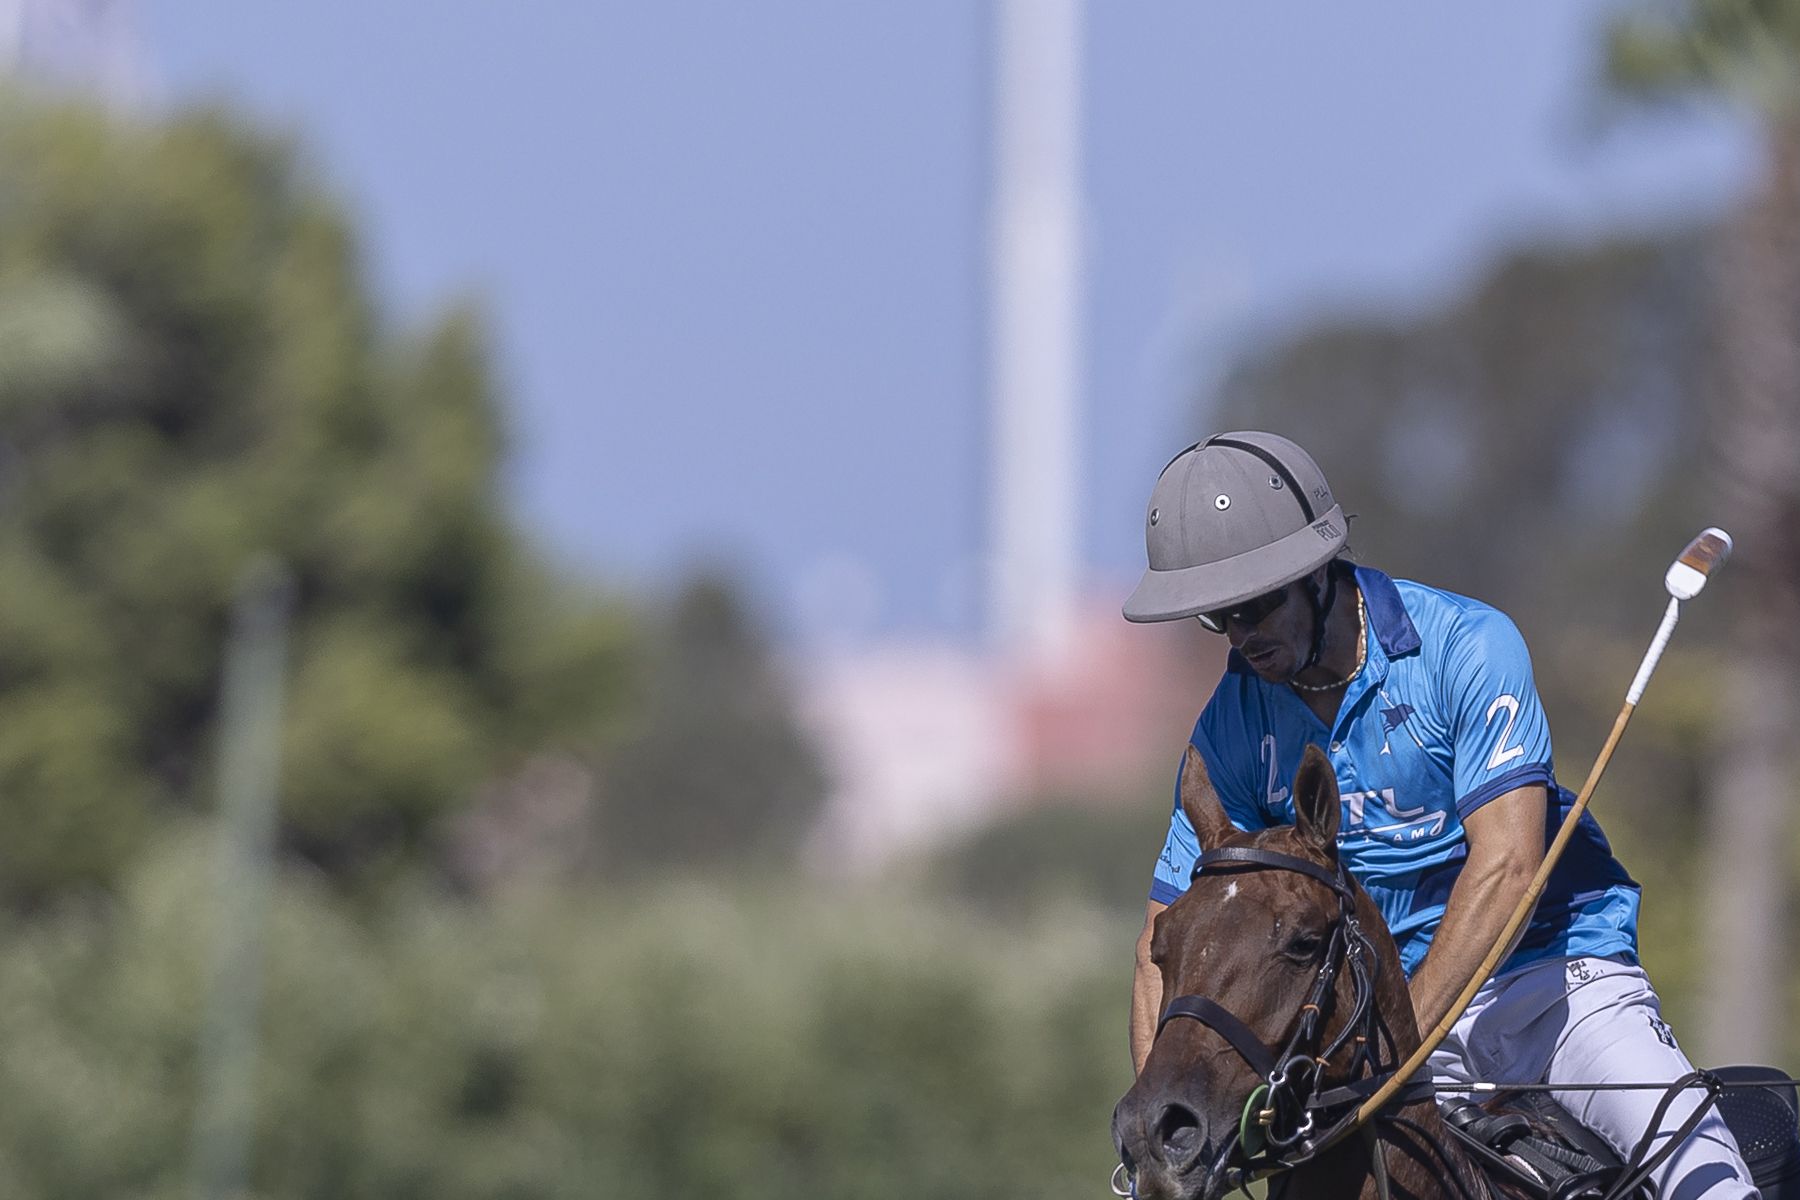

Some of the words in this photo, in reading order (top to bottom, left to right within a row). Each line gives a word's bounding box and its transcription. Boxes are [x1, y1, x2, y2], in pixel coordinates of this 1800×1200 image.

[1486, 694, 1525, 771] 2
[1261, 733, 1288, 804] 2
[1339, 787, 1425, 826] TL
